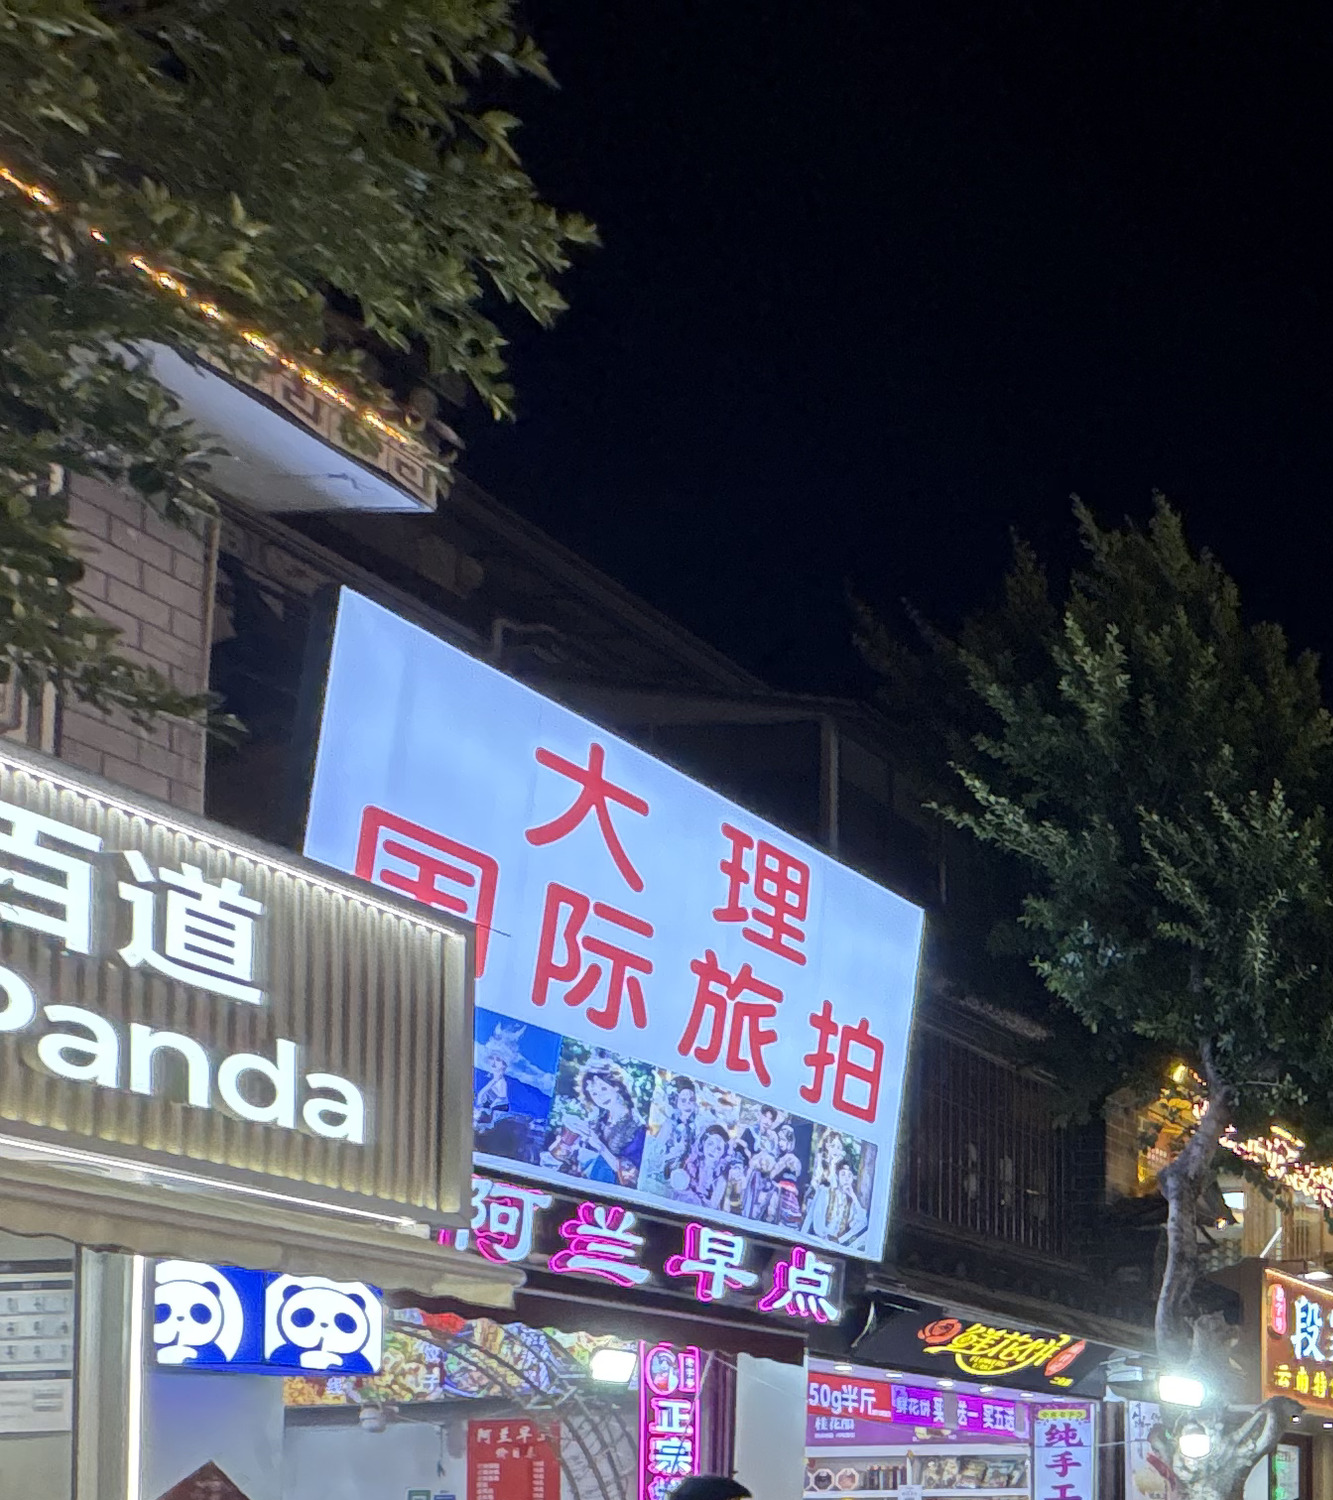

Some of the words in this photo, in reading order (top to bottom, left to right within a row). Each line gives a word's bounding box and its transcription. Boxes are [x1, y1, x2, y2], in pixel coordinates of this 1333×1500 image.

[0, 802, 266, 1006] 百道
[525, 742, 809, 967] 大理
[355, 806, 885, 1124] 国际旅拍
[455, 1174, 841, 1324] 阿兰早点
